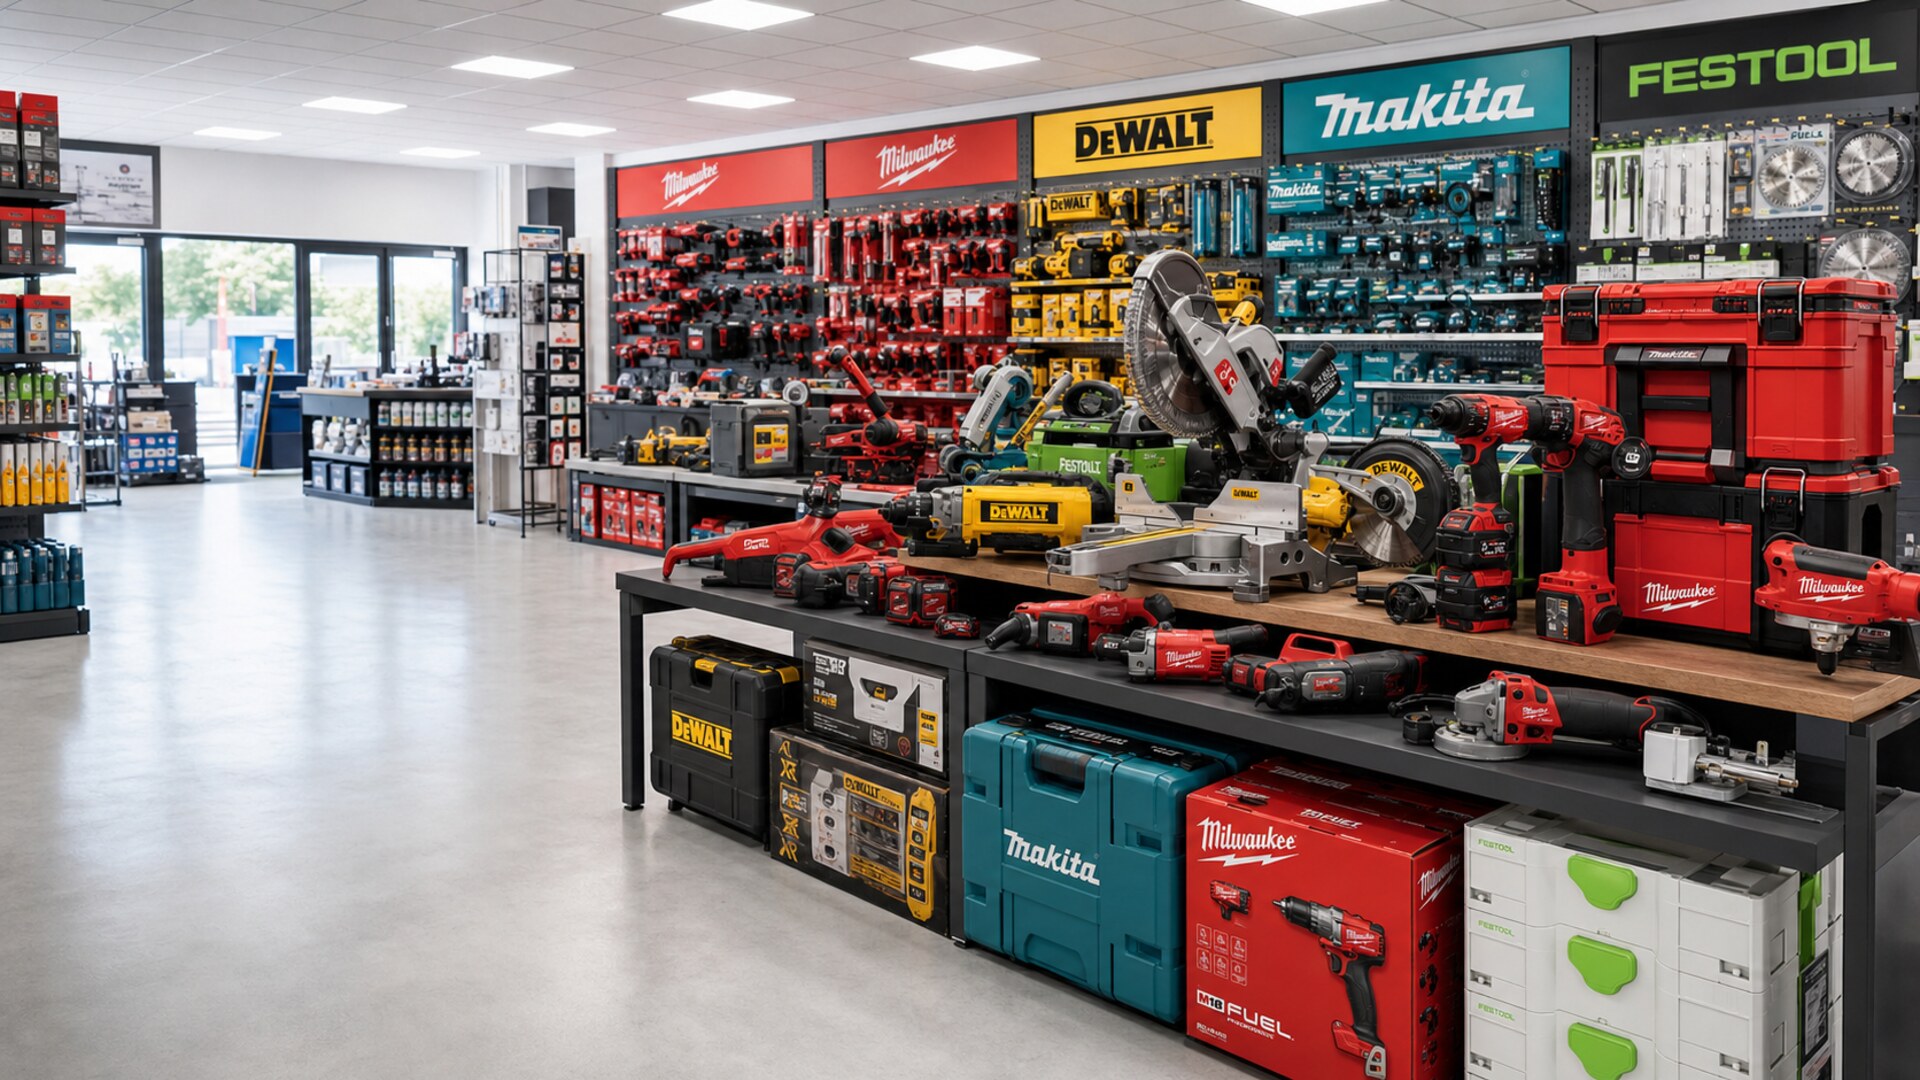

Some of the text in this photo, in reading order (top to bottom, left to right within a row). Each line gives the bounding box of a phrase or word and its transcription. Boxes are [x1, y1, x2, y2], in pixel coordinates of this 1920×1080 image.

[1629, 37, 1897, 99] FESTOOL
[876, 133, 957, 179] Milwaukee
[661, 161, 720, 201] Milwaukee
[1641, 580, 1717, 604] Milwaukee
[1797, 576, 1865, 595] Milwaukee
[1196, 816, 1297, 852] Milwaukee
[1477, 838, 1515, 854] FESTOOL
[1477, 919, 1515, 937] FESTOOL
[1227, 1002, 1292, 1039] FUEL
